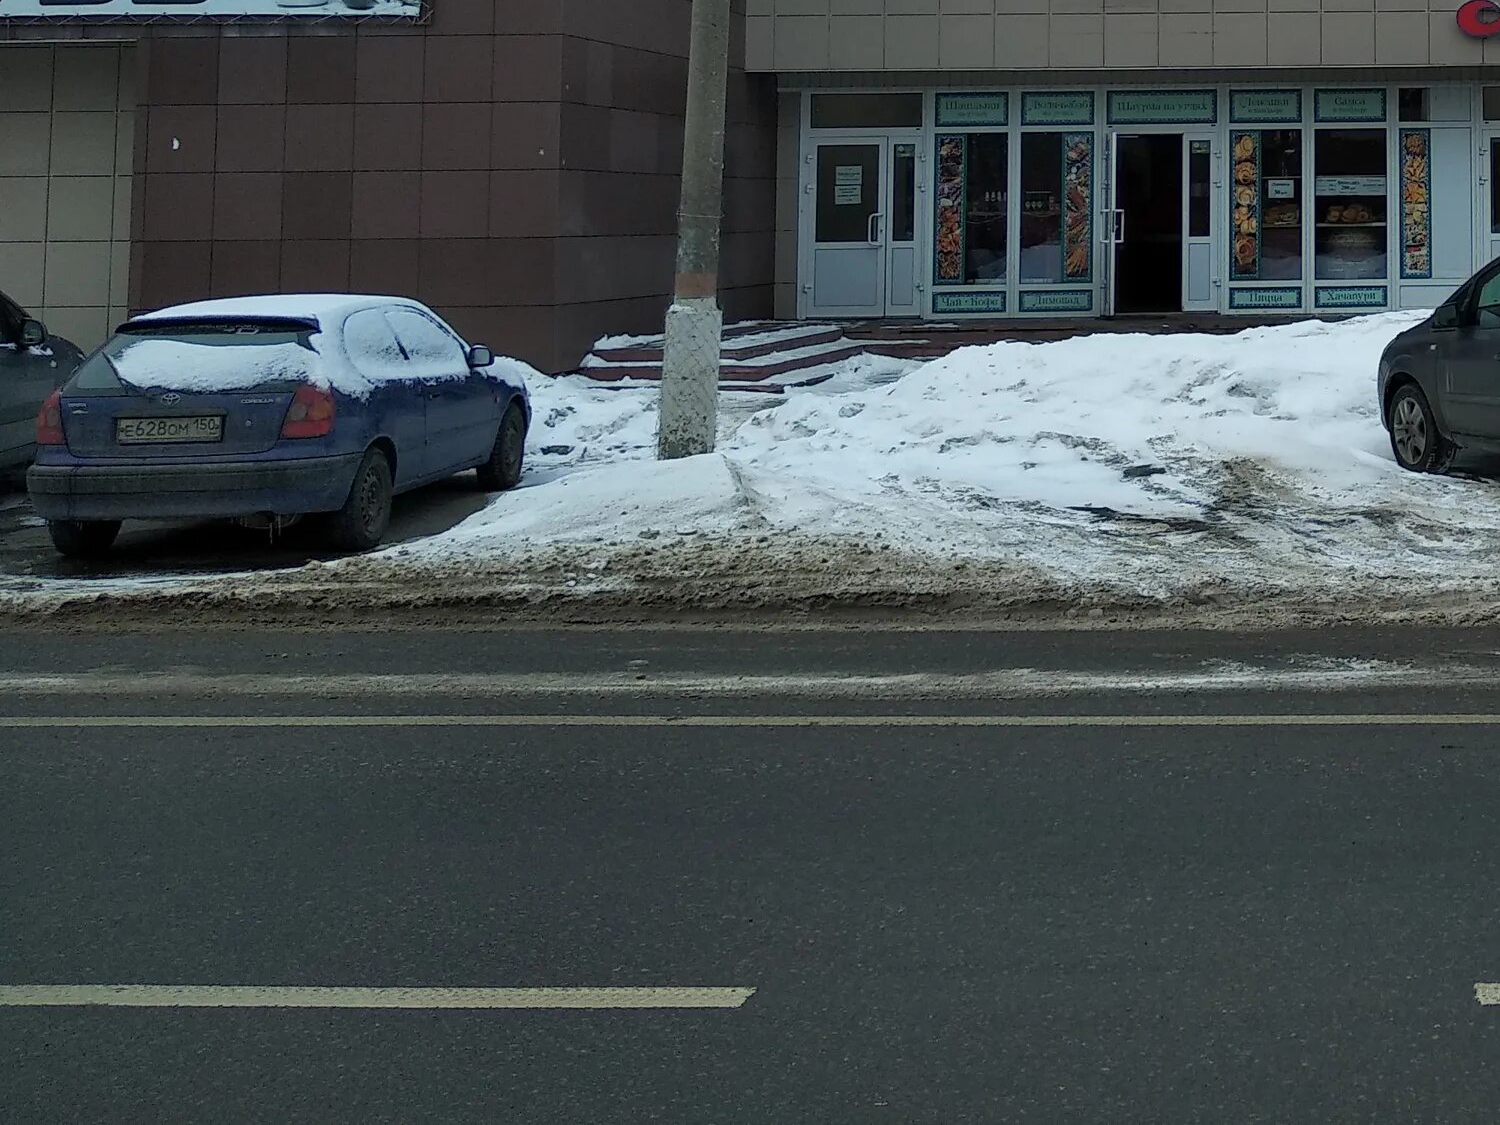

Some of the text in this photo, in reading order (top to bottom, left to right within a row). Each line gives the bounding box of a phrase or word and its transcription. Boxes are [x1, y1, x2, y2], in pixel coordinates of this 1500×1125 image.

[1117, 102, 1161, 113] Шаурма
[1163, 102, 1175, 111] на
[942, 296, 962, 307] Чай
[1249, 292, 1283, 304] Пицца
[1327, 291, 1376, 304] Хачапури
